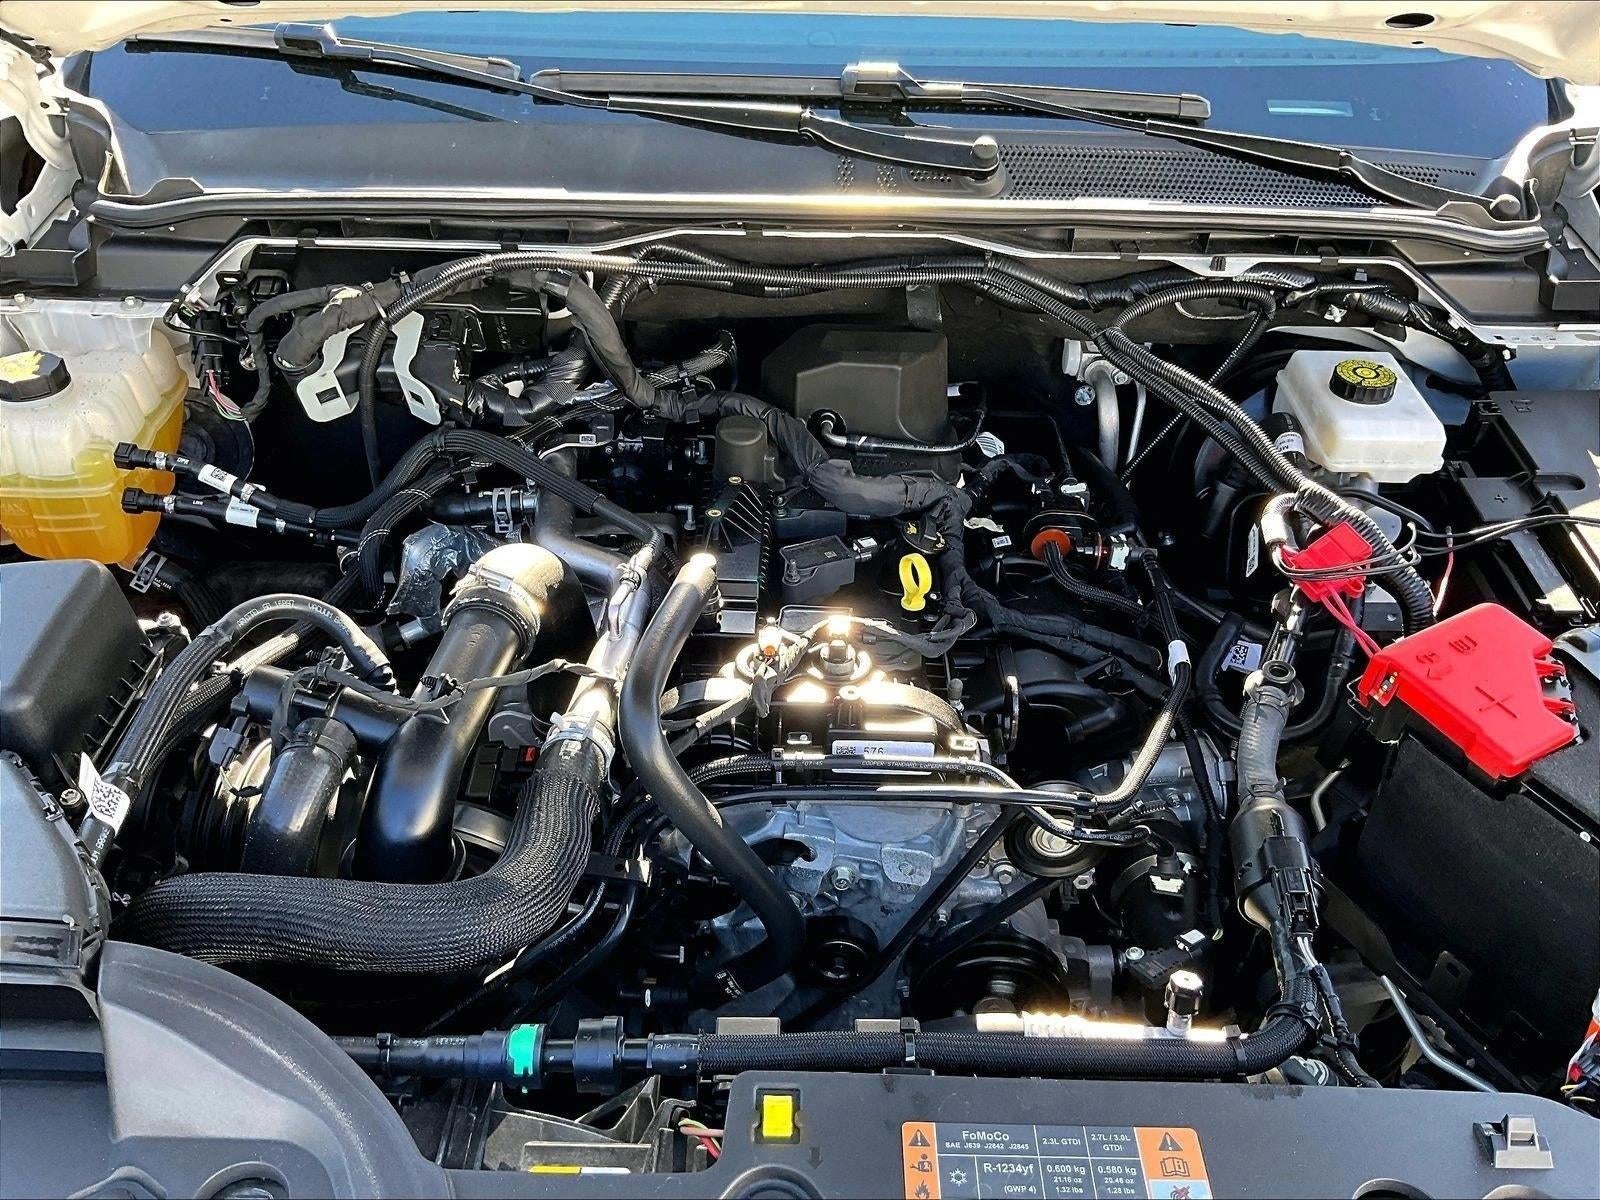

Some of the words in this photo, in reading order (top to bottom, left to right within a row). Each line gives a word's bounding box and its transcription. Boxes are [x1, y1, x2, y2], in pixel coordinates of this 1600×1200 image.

[962, 1130, 1010, 1141] FoMoCo
[1091, 1133, 1108, 1141] 2.7L
[983, 1163, 1034, 1175] R-1234yf
[1046, 1164, 1071, 1173] 0.600
[1073, 1164, 1086, 1175] kg
[1097, 1165, 1122, 1174] 0.580
[1124, 1165, 1137, 1176] kg
[1004, 1185, 1026, 1194] (GWP
[1028, 1185, 1037, 1195] 4)
